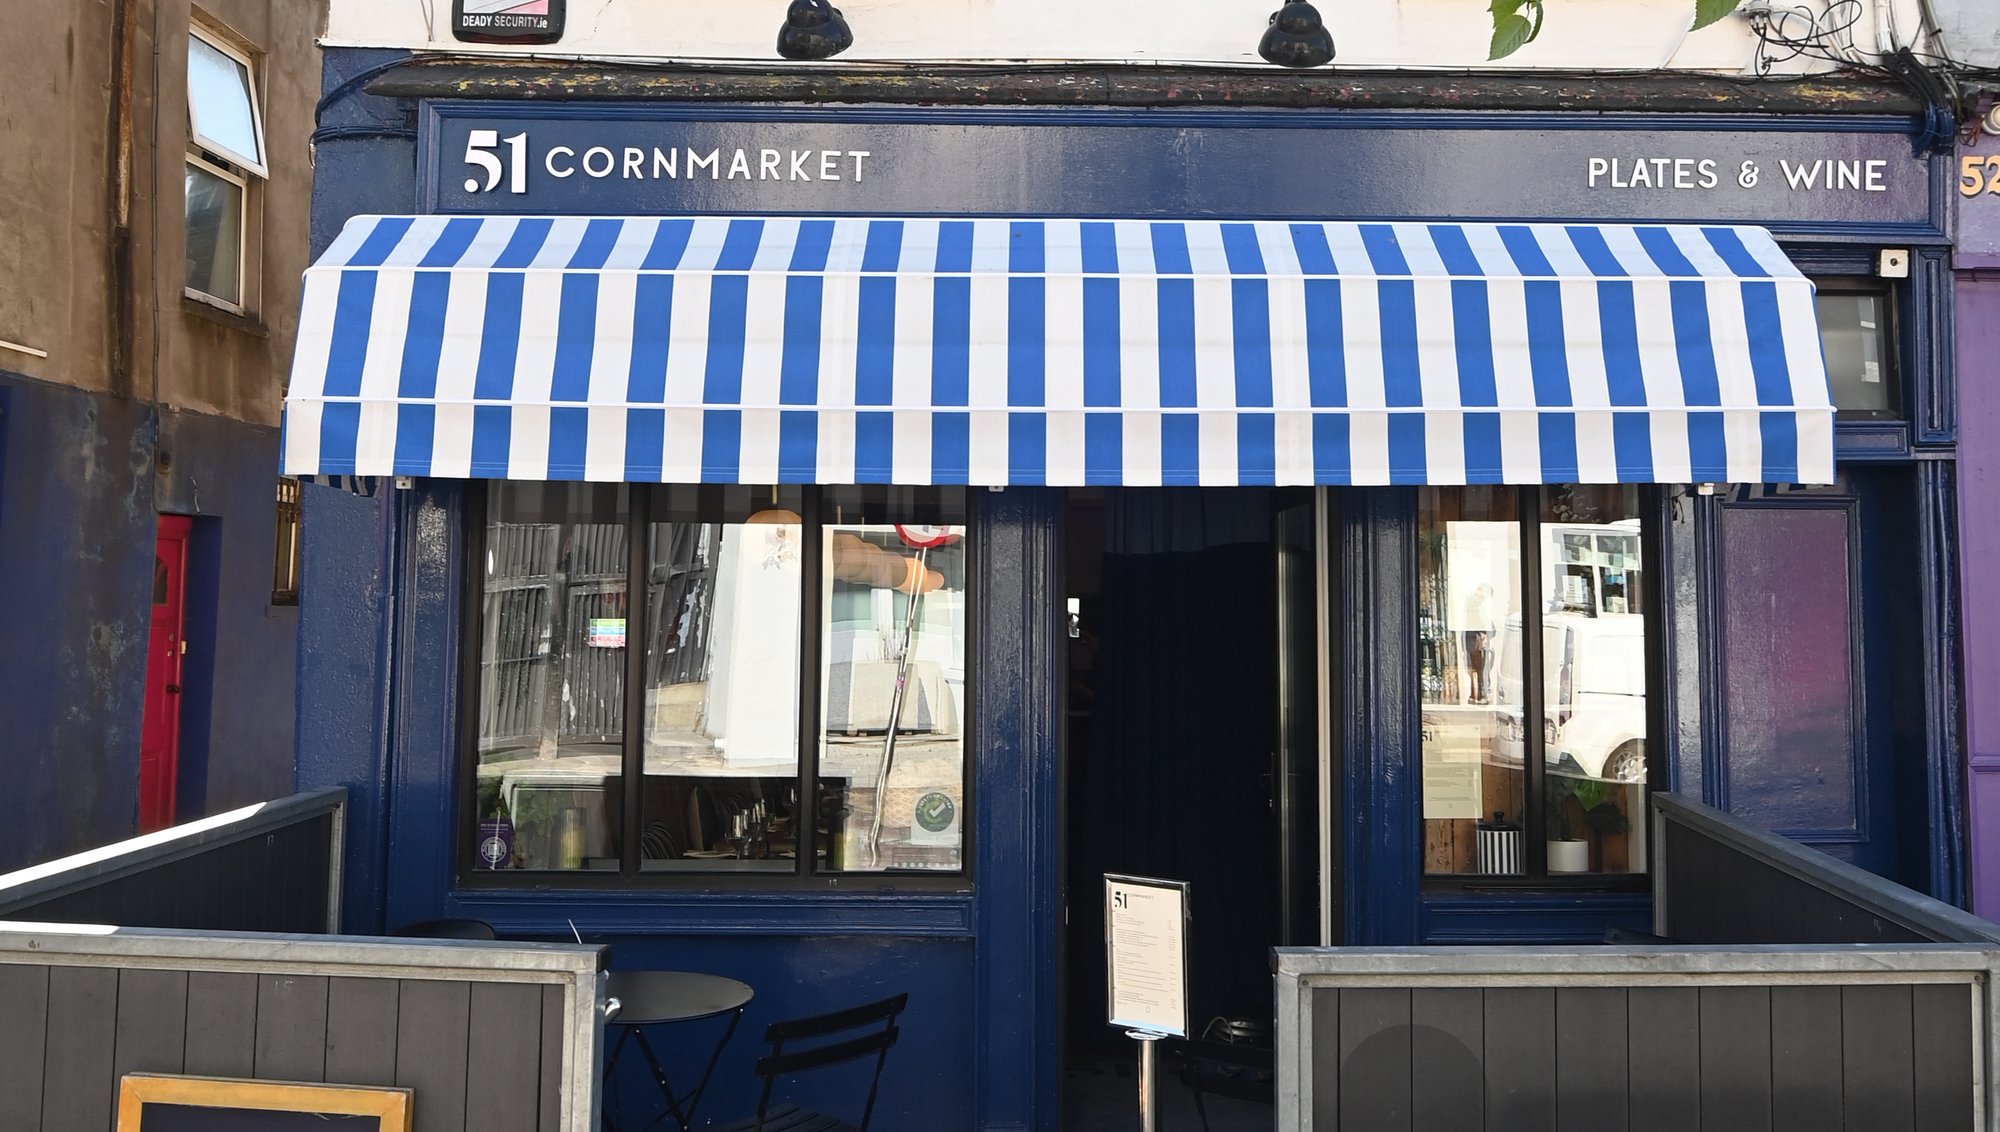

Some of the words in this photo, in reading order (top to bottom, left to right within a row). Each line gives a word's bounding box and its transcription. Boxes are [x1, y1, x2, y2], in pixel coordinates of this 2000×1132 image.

[462, 15, 492, 27] DEADY
[494, 15, 548, 28] SECURITY.ie
[464, 130, 527, 193] 51
[545, 146, 871, 182] CORNMARKET
[1588, 157, 1718, 189] PLATES
[1738, 159, 1760, 189] &
[1779, 159, 1888, 191] WINE
[1959, 154, 2000, 196] 52
[1422, 731, 1433, 742] 51
[1114, 891, 1127, 909] 51
